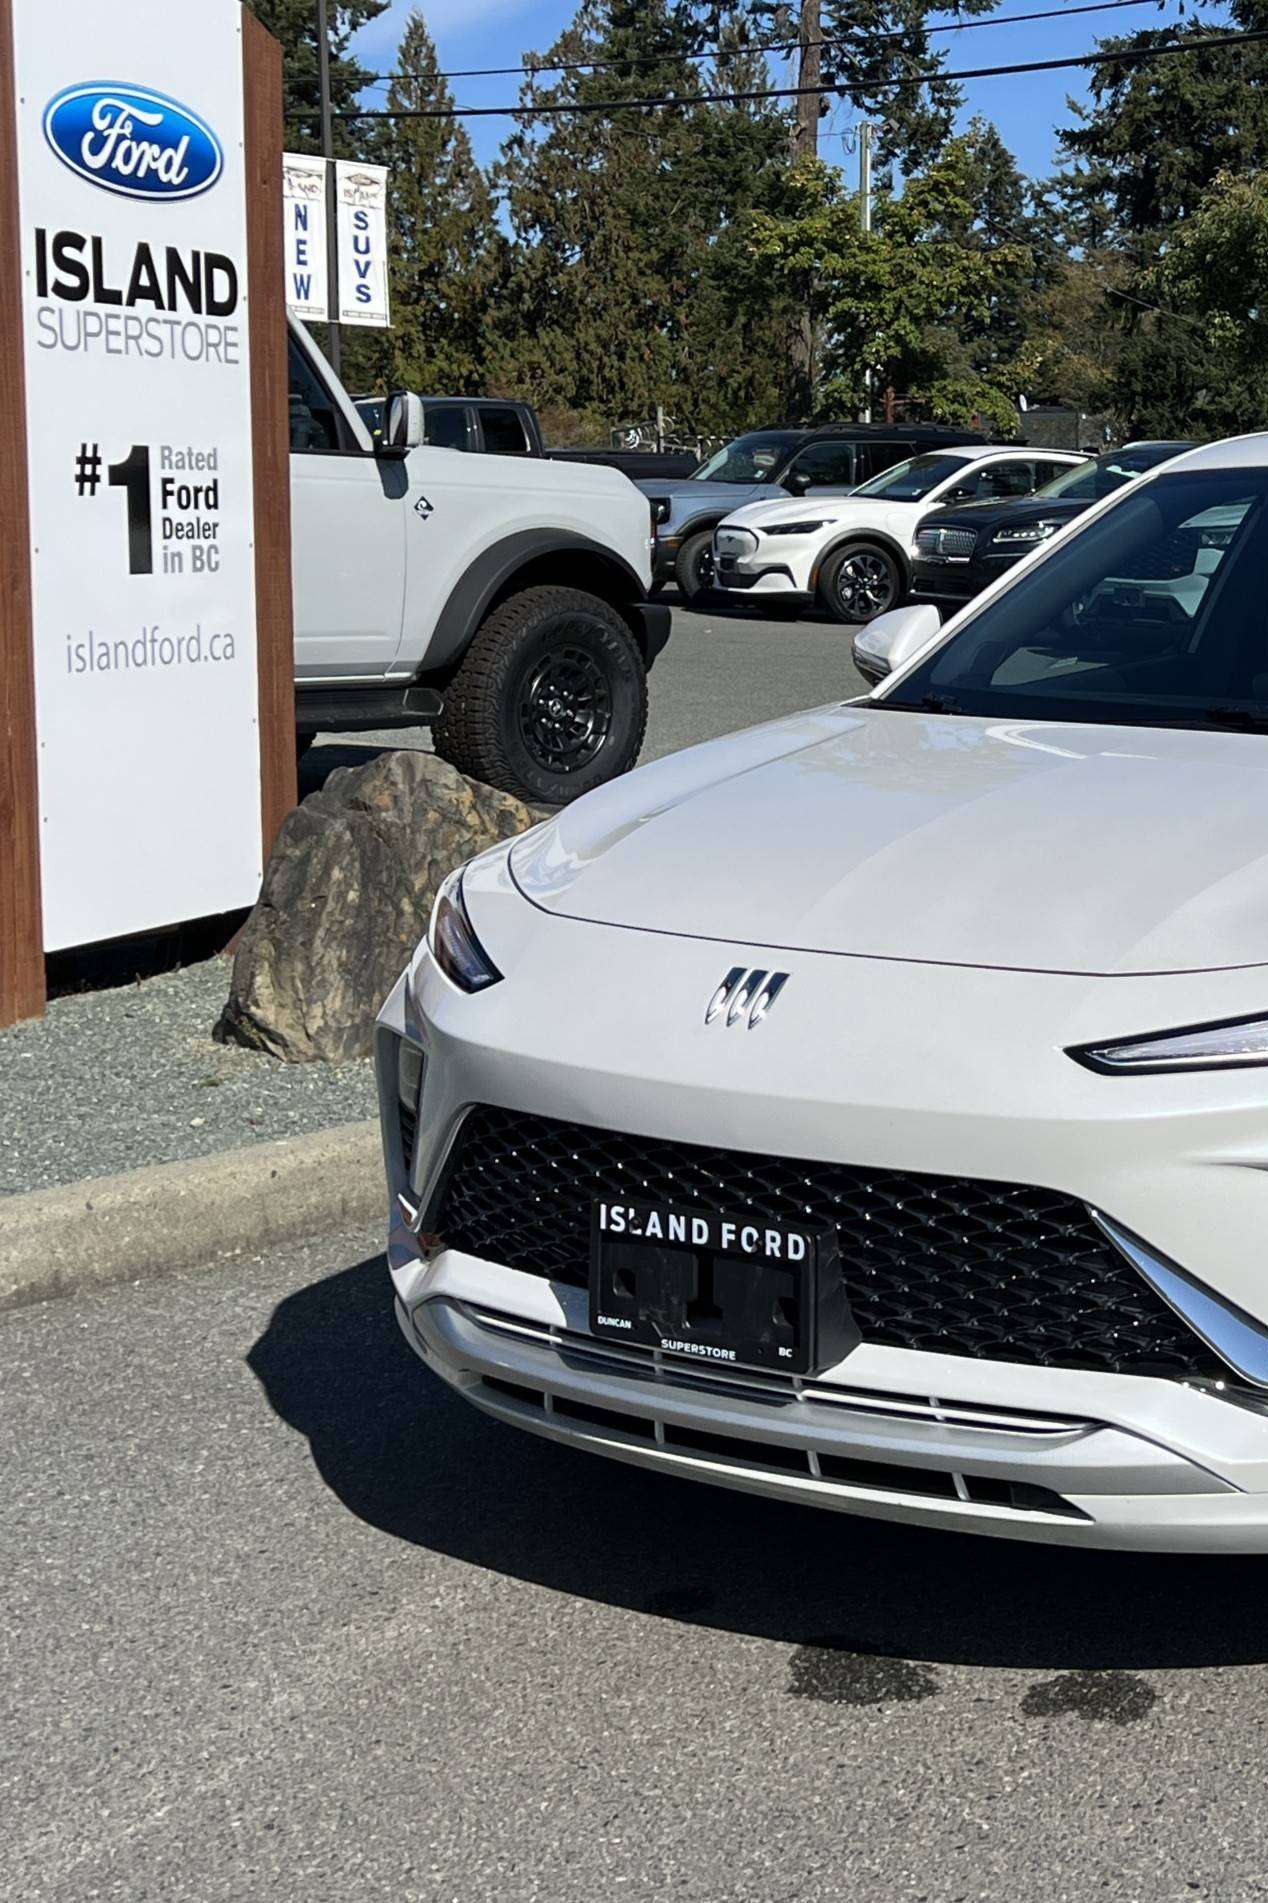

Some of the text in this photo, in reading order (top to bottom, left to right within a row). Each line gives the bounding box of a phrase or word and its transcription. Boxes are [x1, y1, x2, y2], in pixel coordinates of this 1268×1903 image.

[81, 98, 190, 186] Ford
[34, 228, 238, 317] ISLAND
[293, 204, 311, 301] NEW
[353, 211, 371, 303] SUVS
[36, 306, 240, 365] SUPERSTORE
[160, 446, 219, 471] Rated
[161, 478, 219, 511] Ford
[162, 517, 219, 540] Dealer
[163, 544, 220, 573] in BC
[66, 625, 235, 673] islandford.ca
[600, 1204, 805, 1260] ISLAND FORD
[598, 1316, 631, 1328] DUNCAN
[661, 1339, 792, 1360] SUPERSTORE BC
